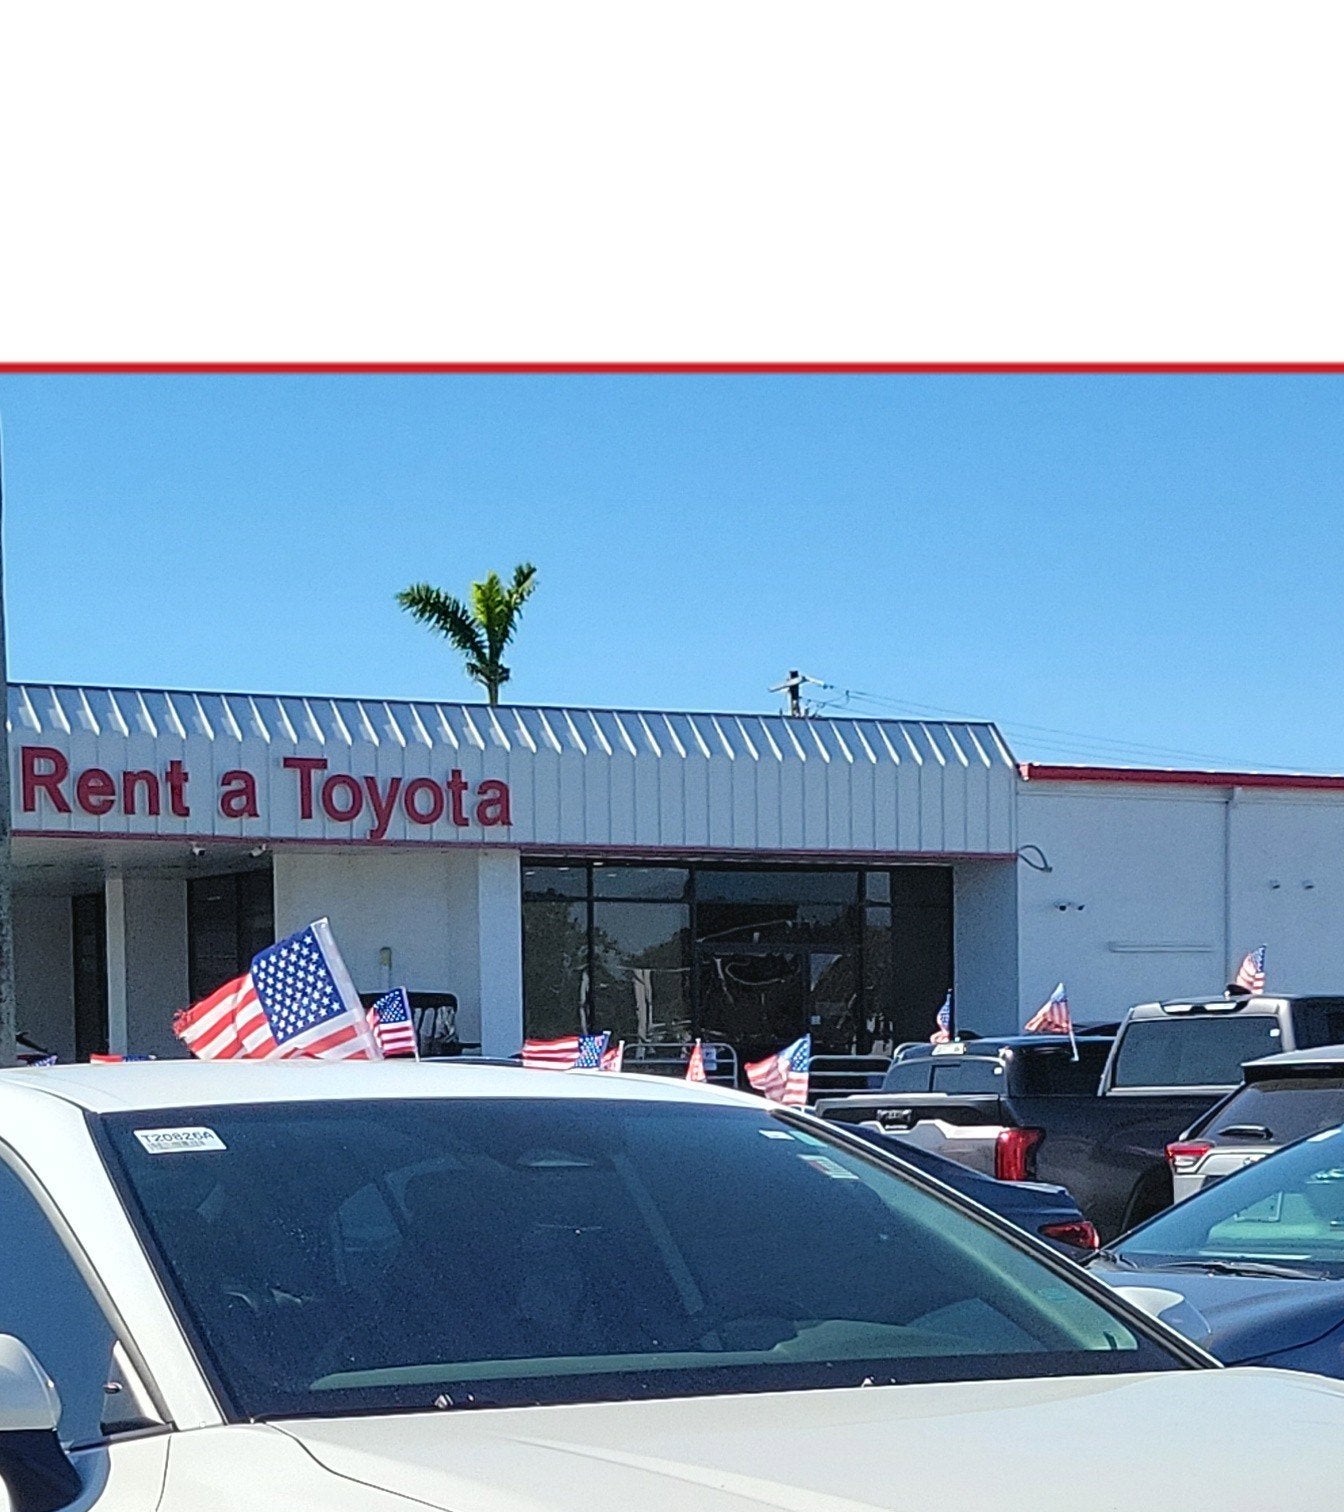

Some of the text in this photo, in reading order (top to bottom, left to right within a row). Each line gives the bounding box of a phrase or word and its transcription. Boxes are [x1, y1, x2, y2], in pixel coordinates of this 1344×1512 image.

[21, 745, 512, 841] Rent a Toyota
